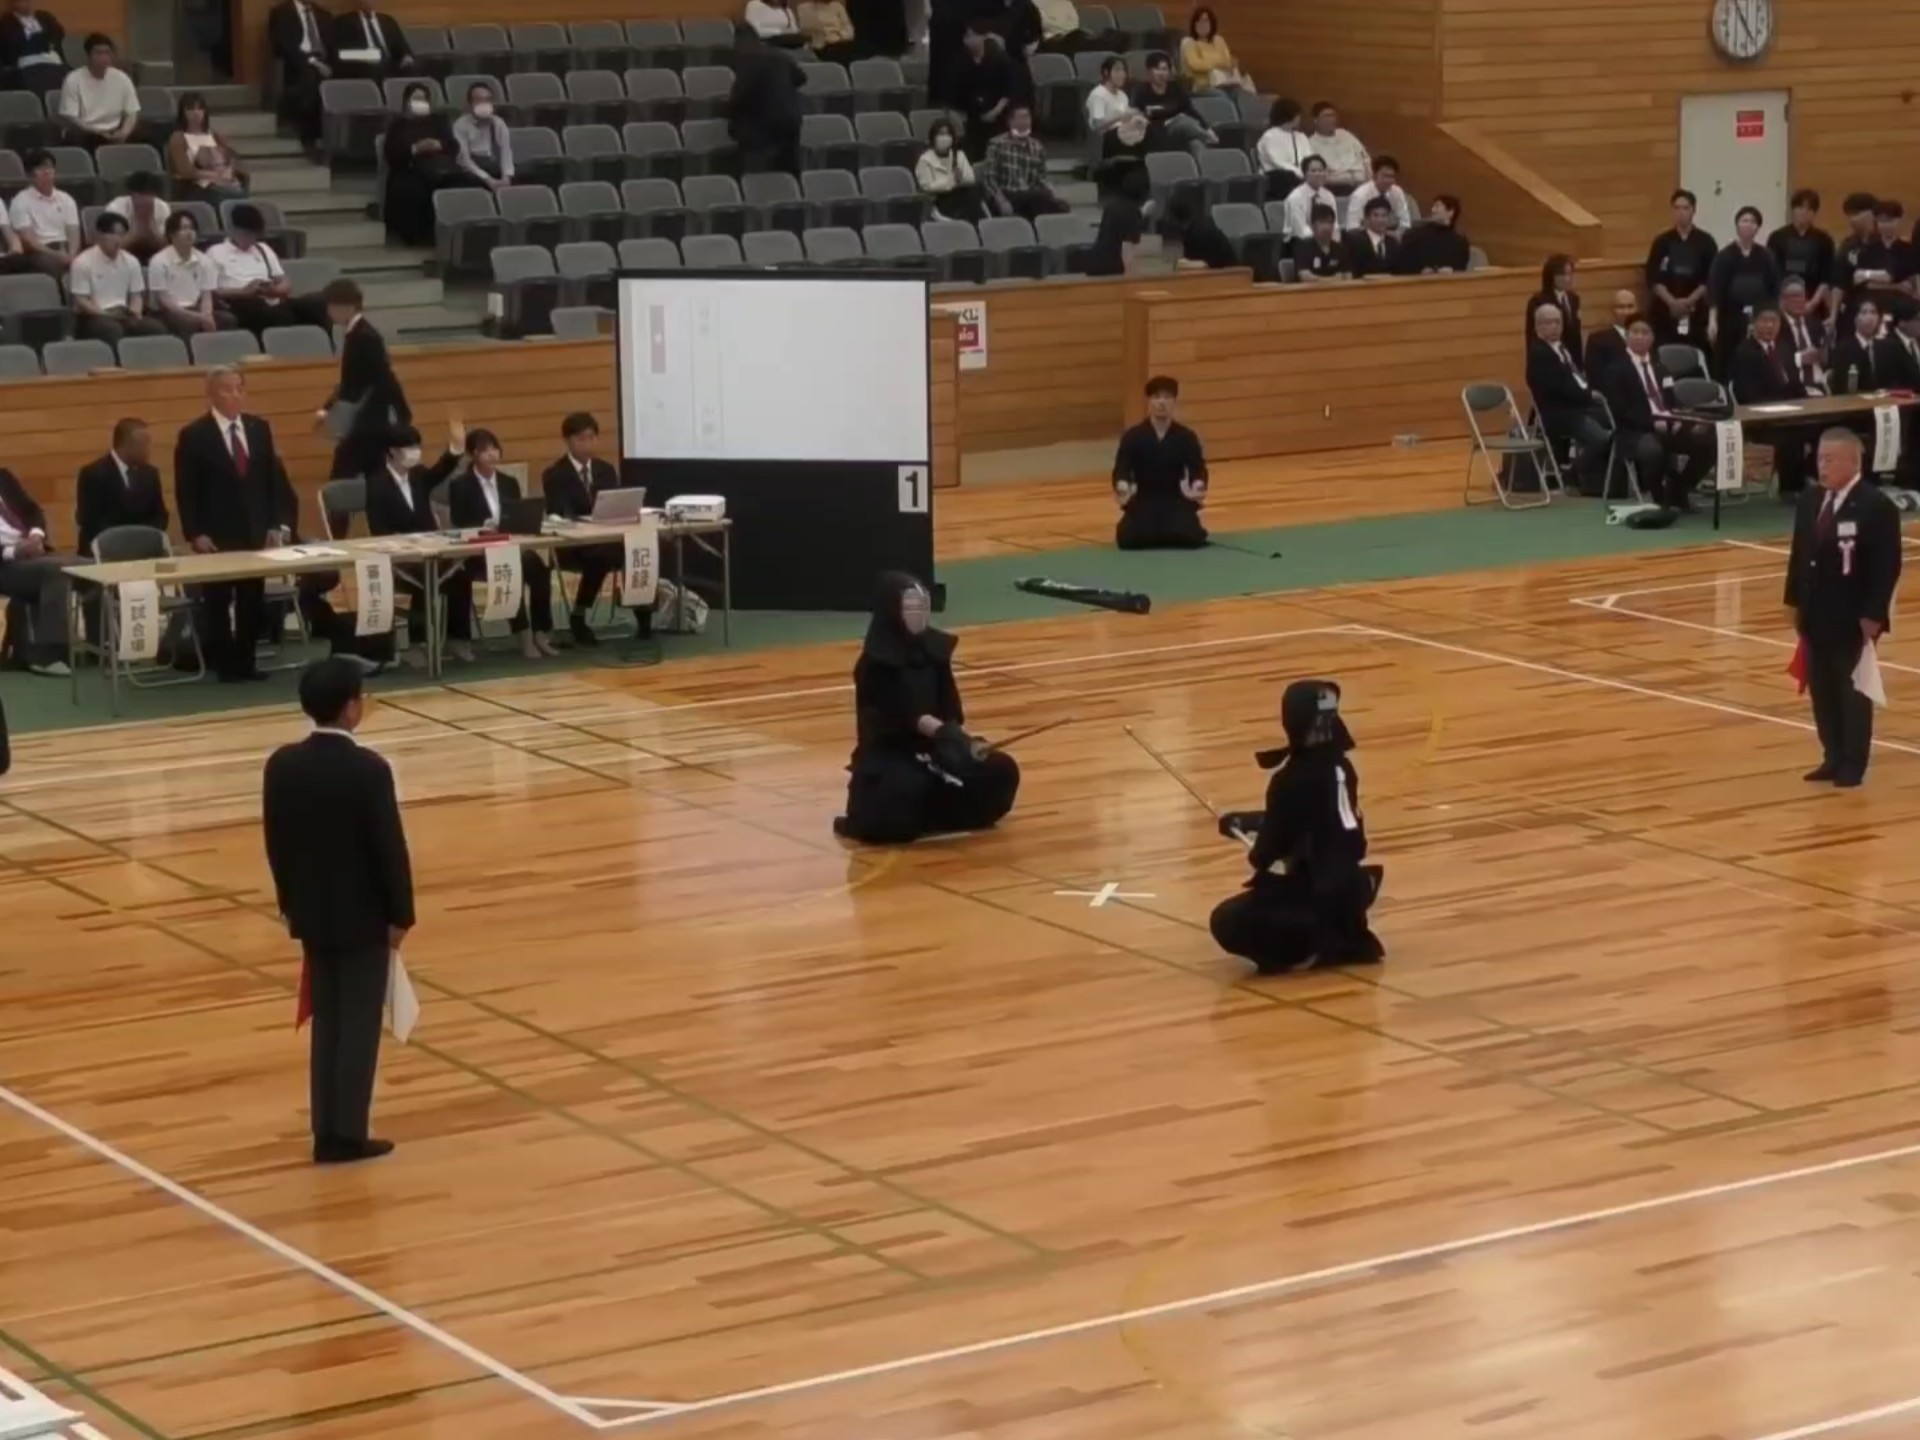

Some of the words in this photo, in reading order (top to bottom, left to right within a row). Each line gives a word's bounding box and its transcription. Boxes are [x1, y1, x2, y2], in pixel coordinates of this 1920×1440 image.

[904, 470, 919, 508] 1
[493, 562, 512, 606] 時計
[631, 547, 651, 590] 記録
